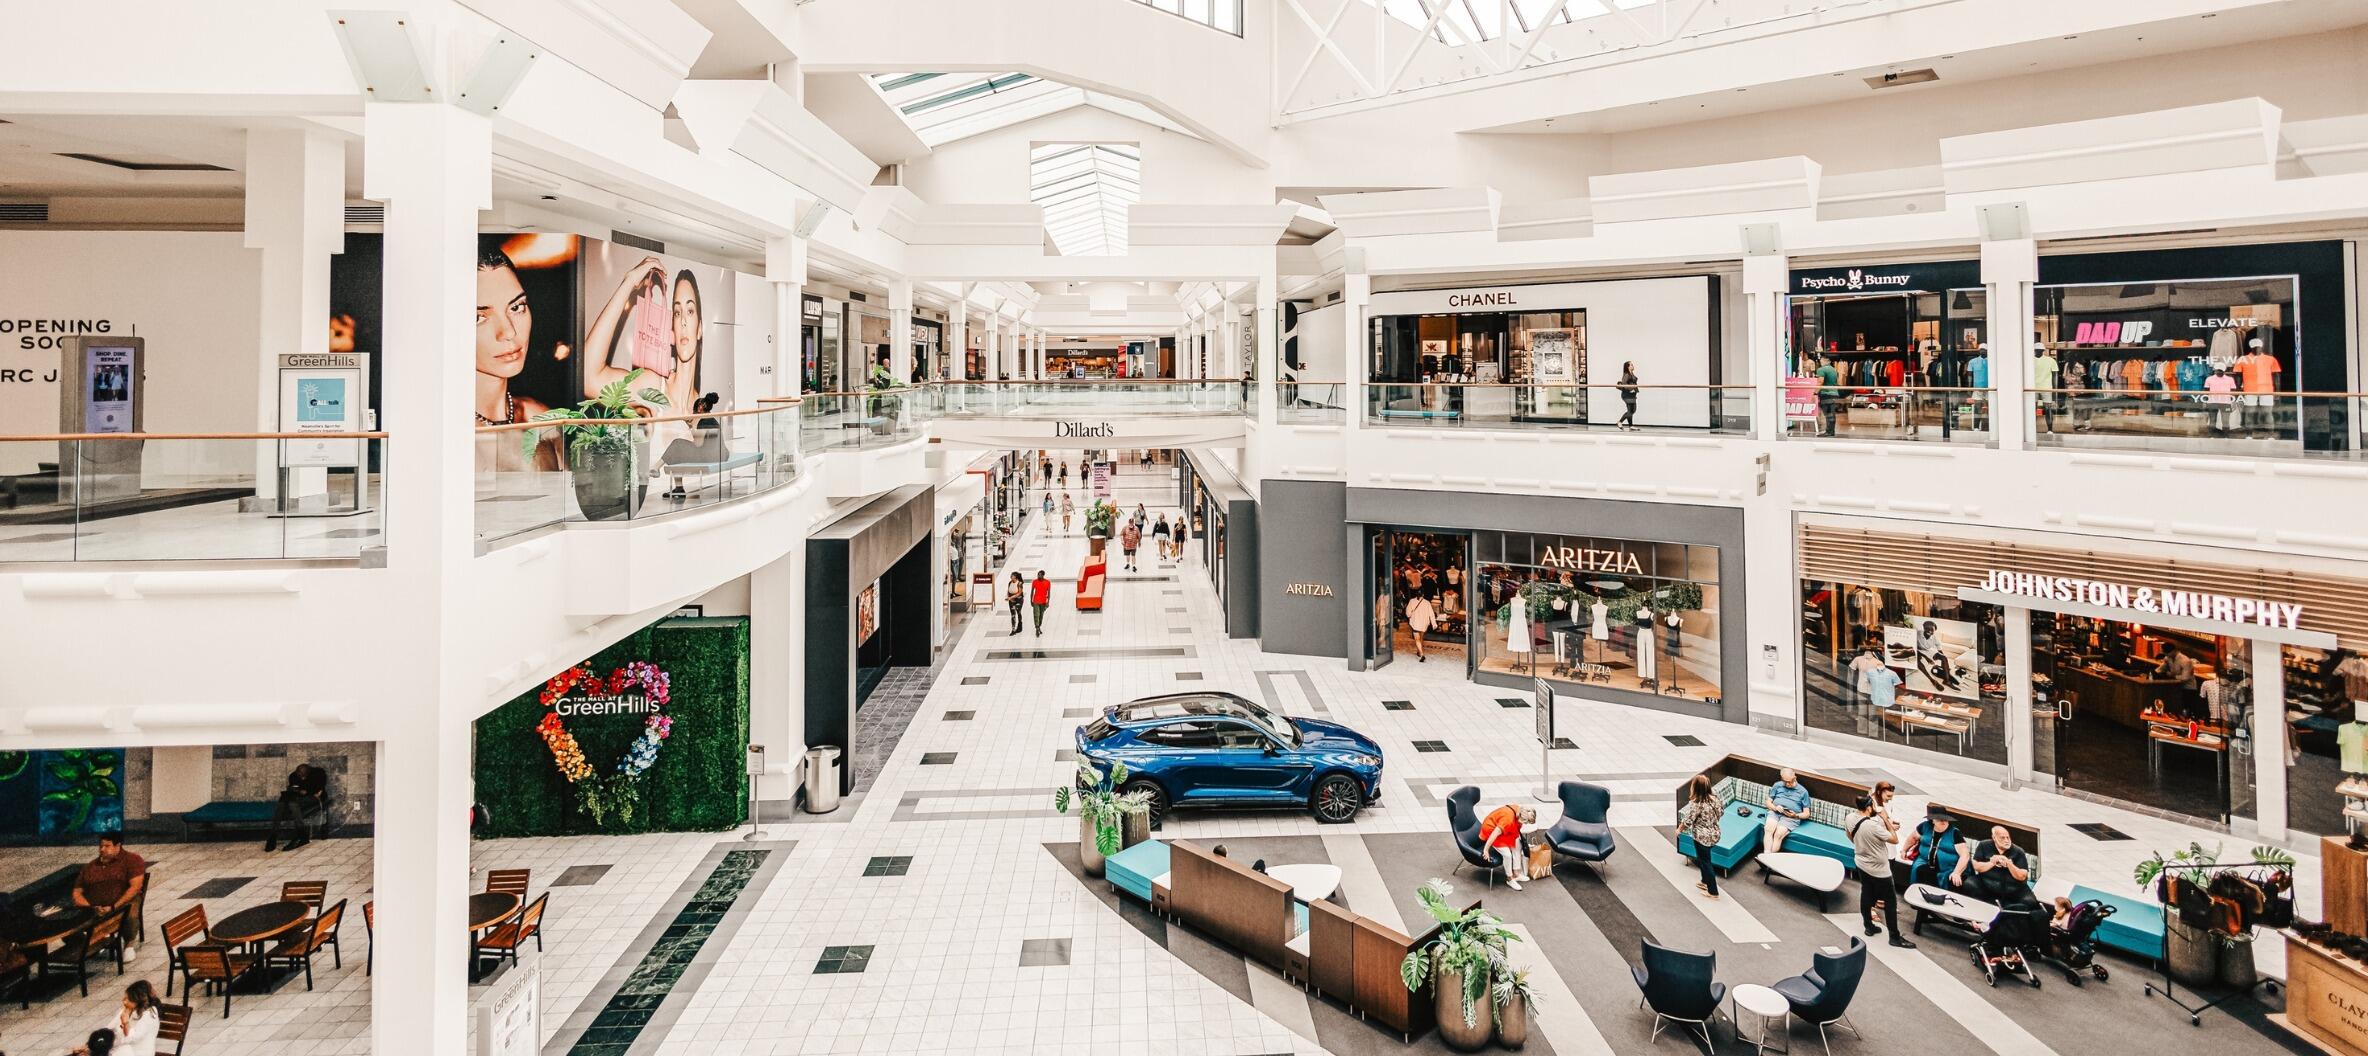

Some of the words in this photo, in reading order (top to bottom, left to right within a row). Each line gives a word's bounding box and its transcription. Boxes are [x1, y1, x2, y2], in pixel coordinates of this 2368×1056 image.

[1801, 276, 1846, 289] Psycho
[1864, 274, 1911, 286] Bunny
[1449, 292, 1517, 307] CHANEL
[0, 319, 111, 333] OPENING
[2188, 317, 2259, 328] ELEVATE
[2075, 321, 2121, 344] DAD
[2120, 320, 2153, 344] UP
[20, 336, 62, 350] SO
[1244, 325, 1253, 368] TAYLOR
[287, 355, 355, 367] GreenHills
[2188, 355, 2217, 365] THE
[2220, 355, 2257, 365] WAY
[1055, 421, 1114, 438] Dillard's
[1540, 545, 1643, 575] ARITZIA
[1286, 583, 1333, 596] ARITZIA
[1980, 569, 2129, 609] JOHNSTON
[2133, 586, 2160, 613] &
[2160, 589, 2303, 631] MURPHY
[1574, 662, 1612, 674] ARITZIA
[555, 695, 660, 716] GreenHills
[494, 966, 536, 1015] GreenHills
[2328, 992, 2368, 1019] CLAY
